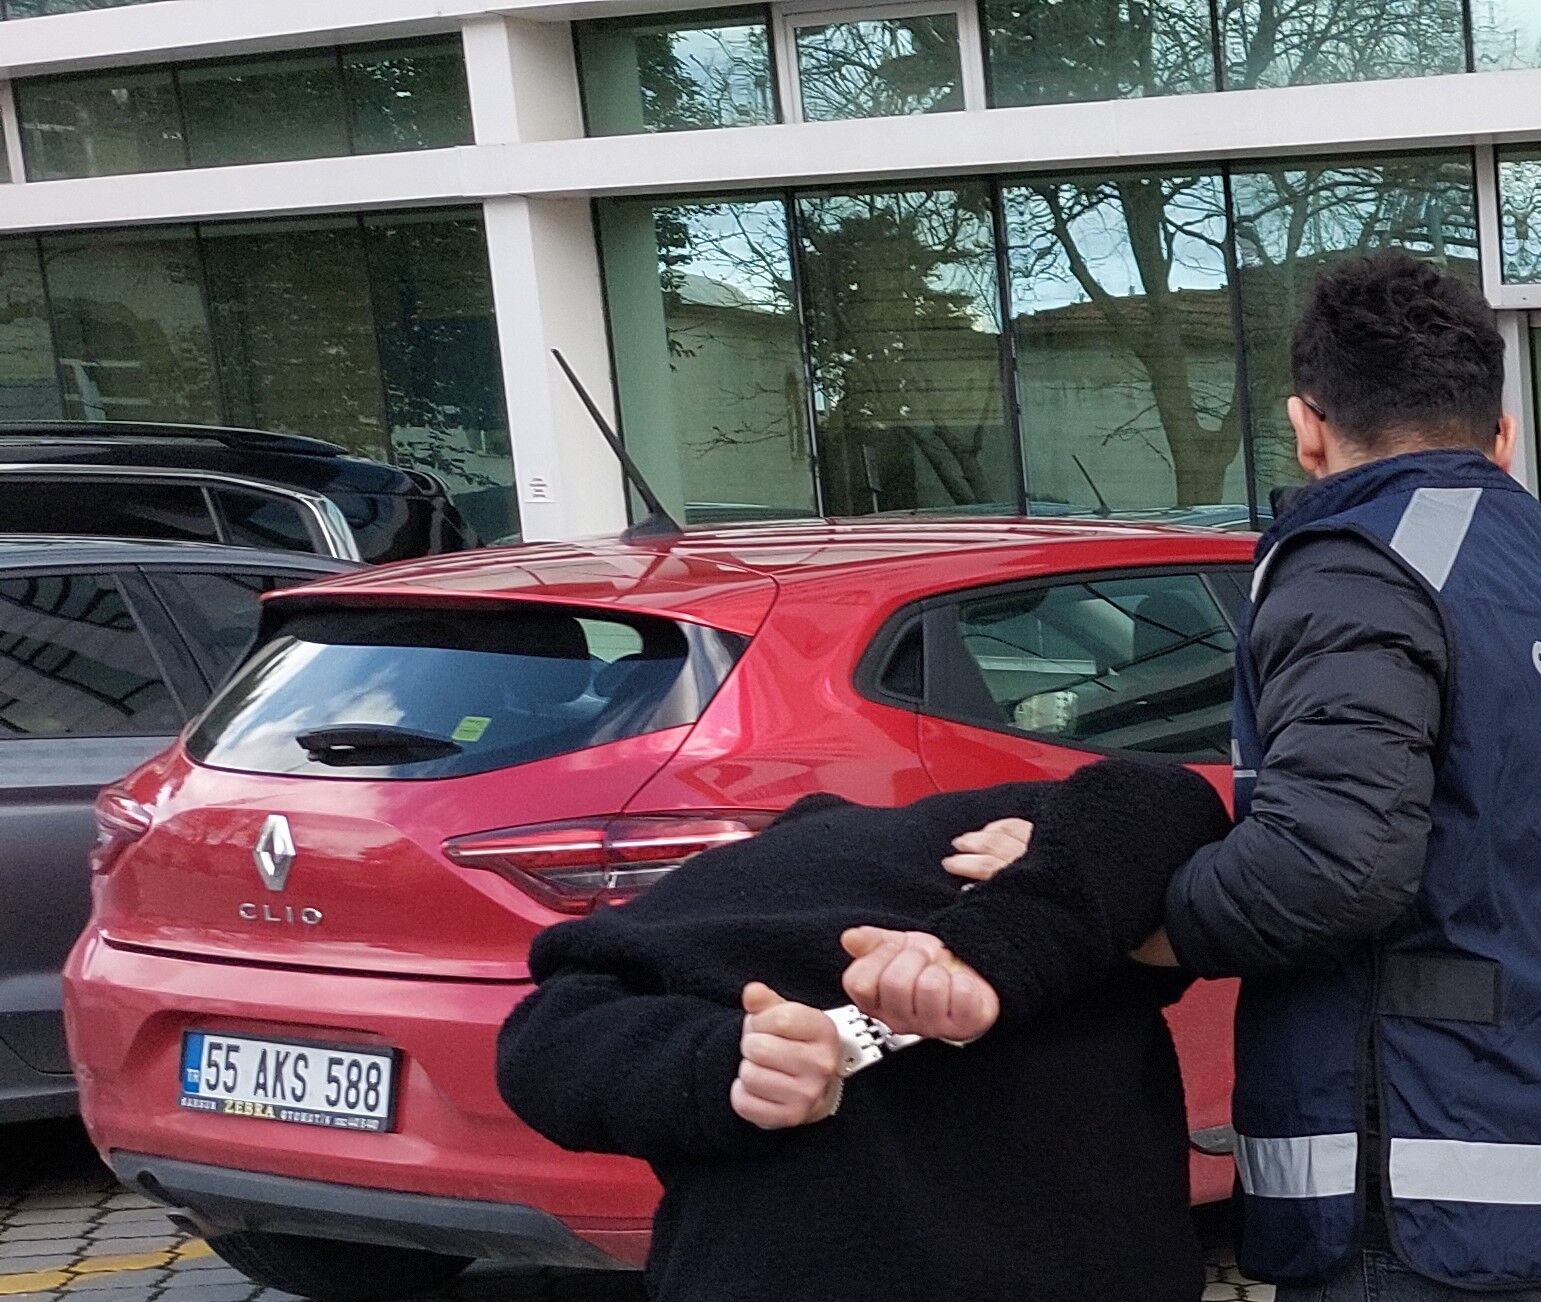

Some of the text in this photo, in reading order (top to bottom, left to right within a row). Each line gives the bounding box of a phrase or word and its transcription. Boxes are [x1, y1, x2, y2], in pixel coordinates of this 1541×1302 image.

[239, 902, 322, 925] CLIO
[205, 1041, 382, 1112] 55 AKS 588
[223, 1099, 276, 1119] ZEBRA
